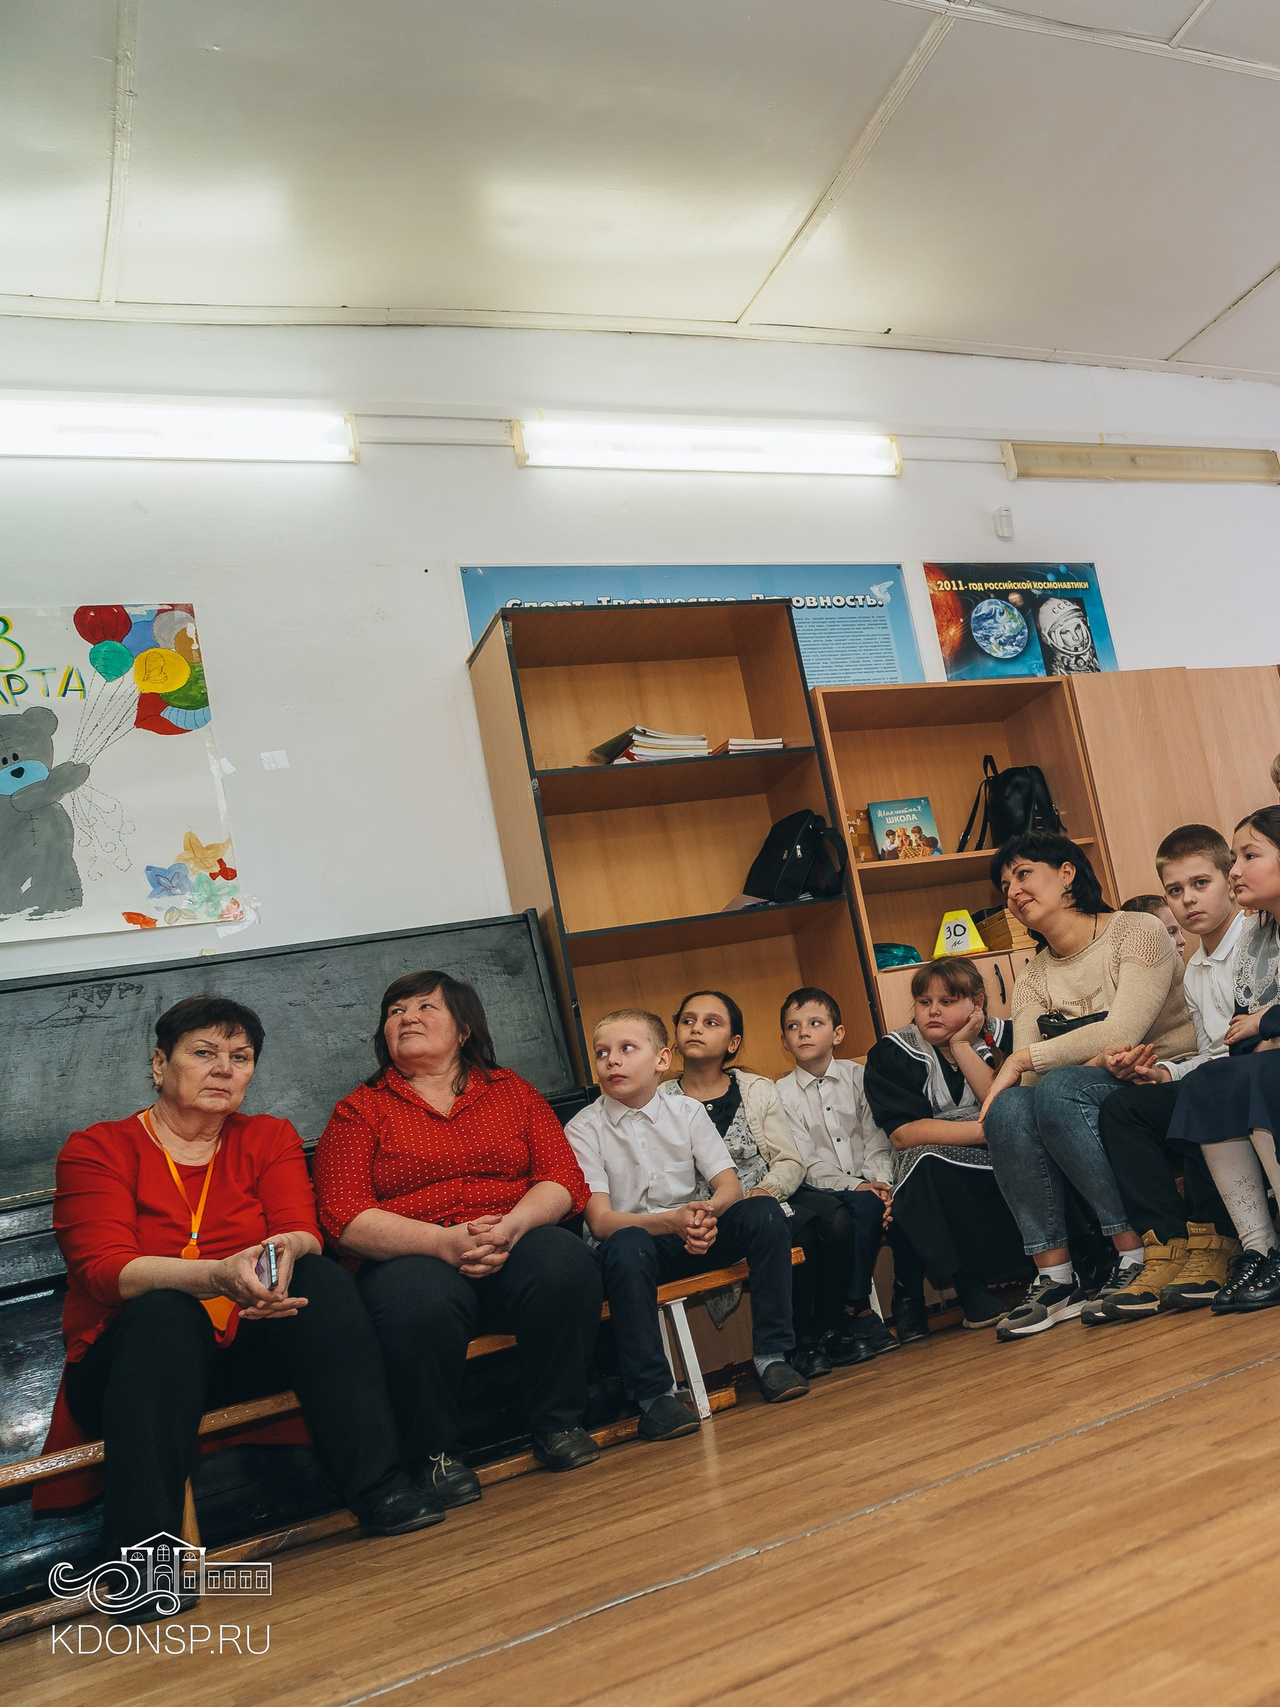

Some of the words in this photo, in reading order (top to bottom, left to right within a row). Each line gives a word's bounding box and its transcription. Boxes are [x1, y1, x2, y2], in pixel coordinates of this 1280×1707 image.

[936, 580, 968, 591] 2011-
[984, 580, 1032, 591] РОССИЙСКОЙ
[1033, 581, 1090, 590] КОСМОНАВТИКИ
[1052, 600, 1075, 615] ССС
[885, 814, 918, 824] ШКОЛА
[945, 923, 967, 940] 30
